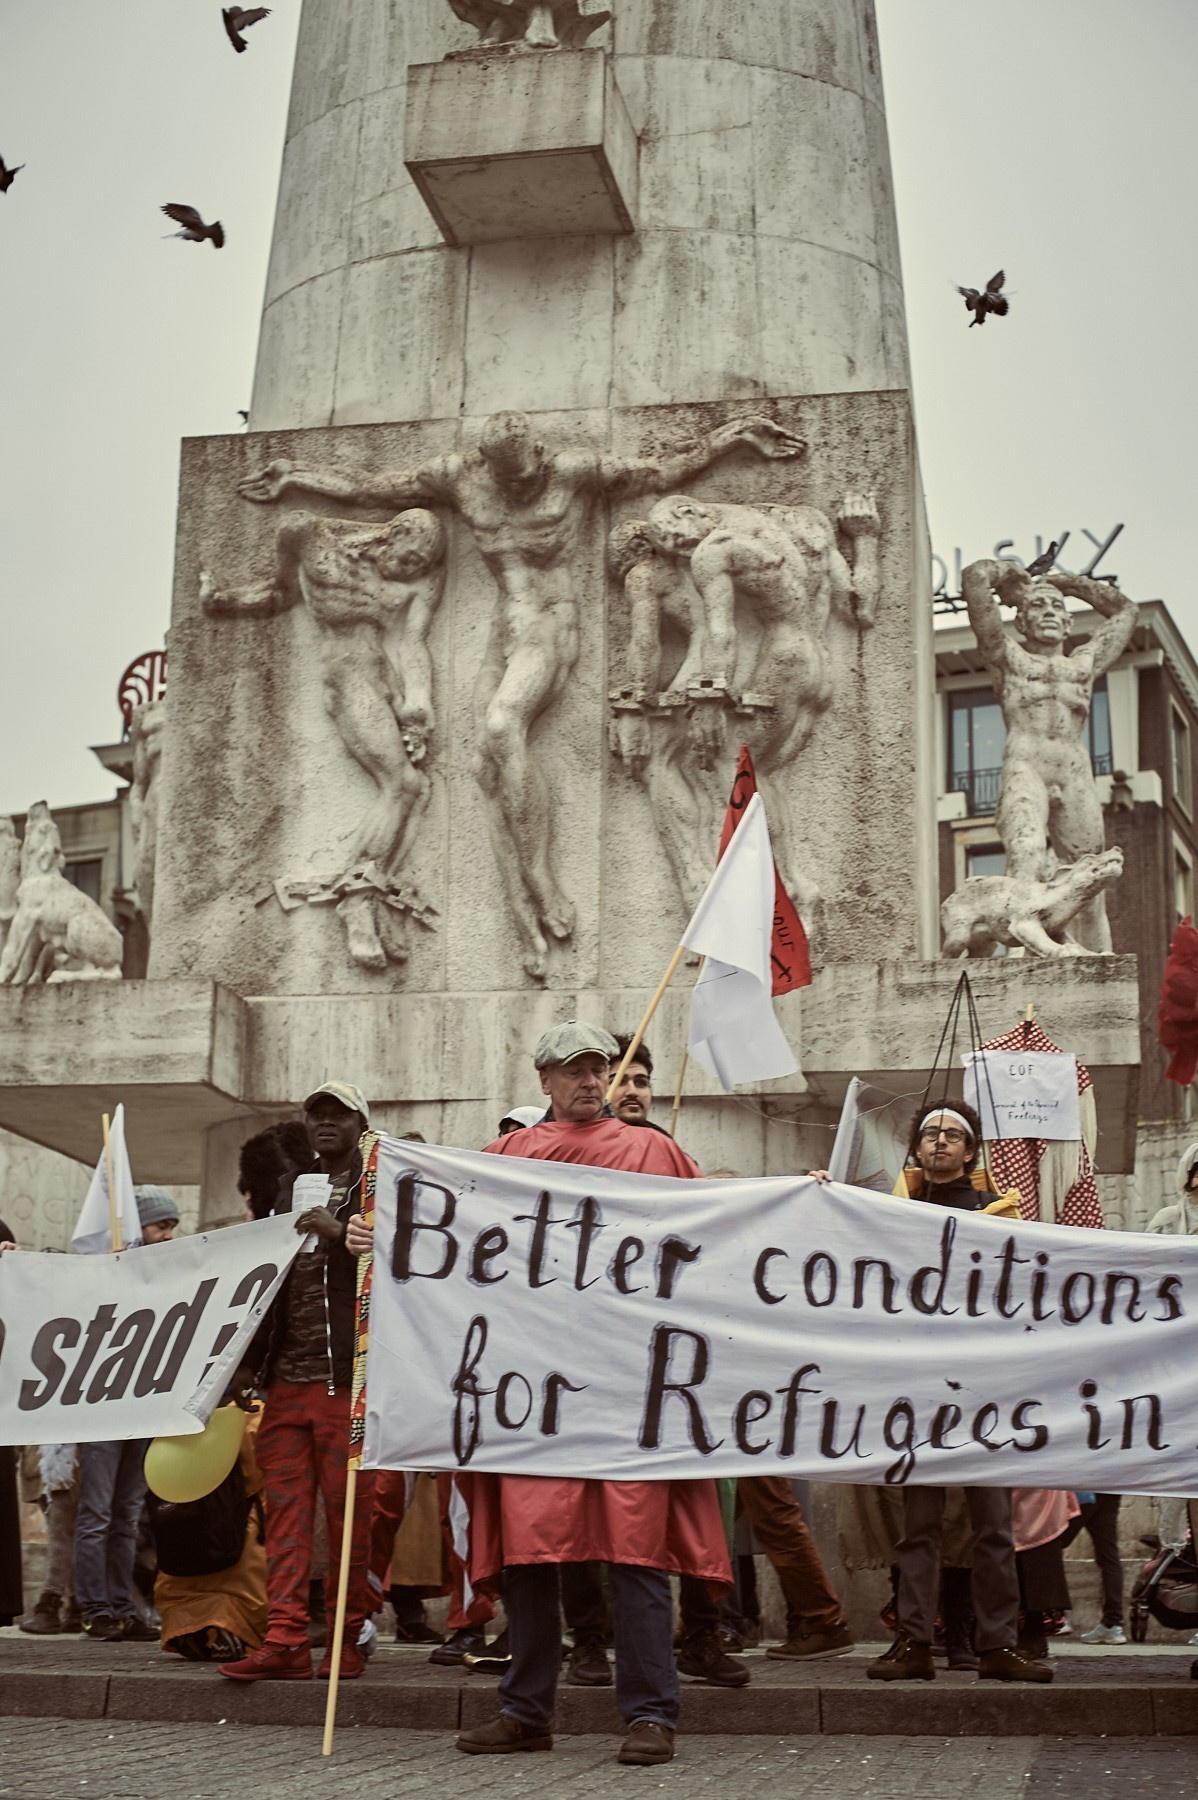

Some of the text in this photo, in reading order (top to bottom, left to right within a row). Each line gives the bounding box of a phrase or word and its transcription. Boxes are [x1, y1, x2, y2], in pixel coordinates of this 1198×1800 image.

[391, 1170, 1184, 1326] Better conditions
[452, 1314, 590, 1466] for
[1079, 1379, 1170, 1451] in
